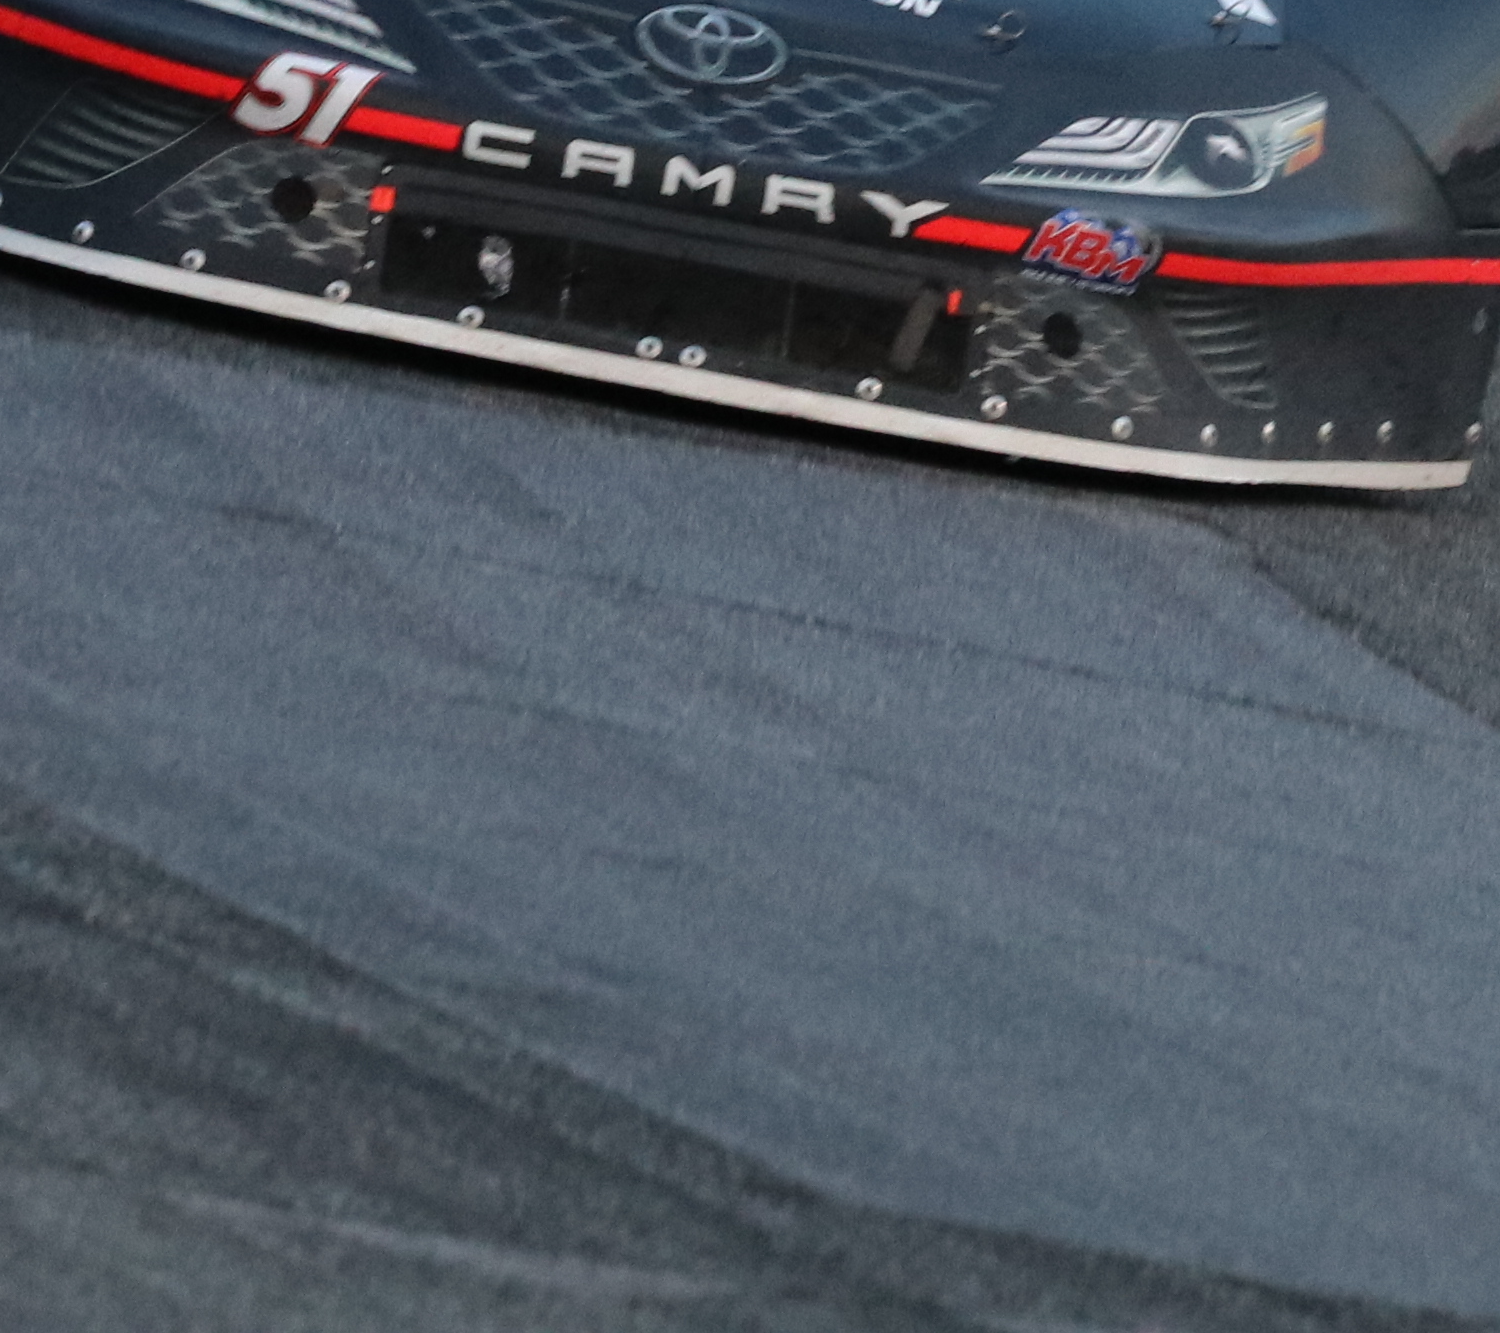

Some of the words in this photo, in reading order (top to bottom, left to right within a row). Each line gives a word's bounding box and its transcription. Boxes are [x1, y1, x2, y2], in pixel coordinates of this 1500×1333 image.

[234, 52, 383, 148] 51
[461, 123, 950, 238] CAMRY
[1022, 217, 1152, 284] KBM
